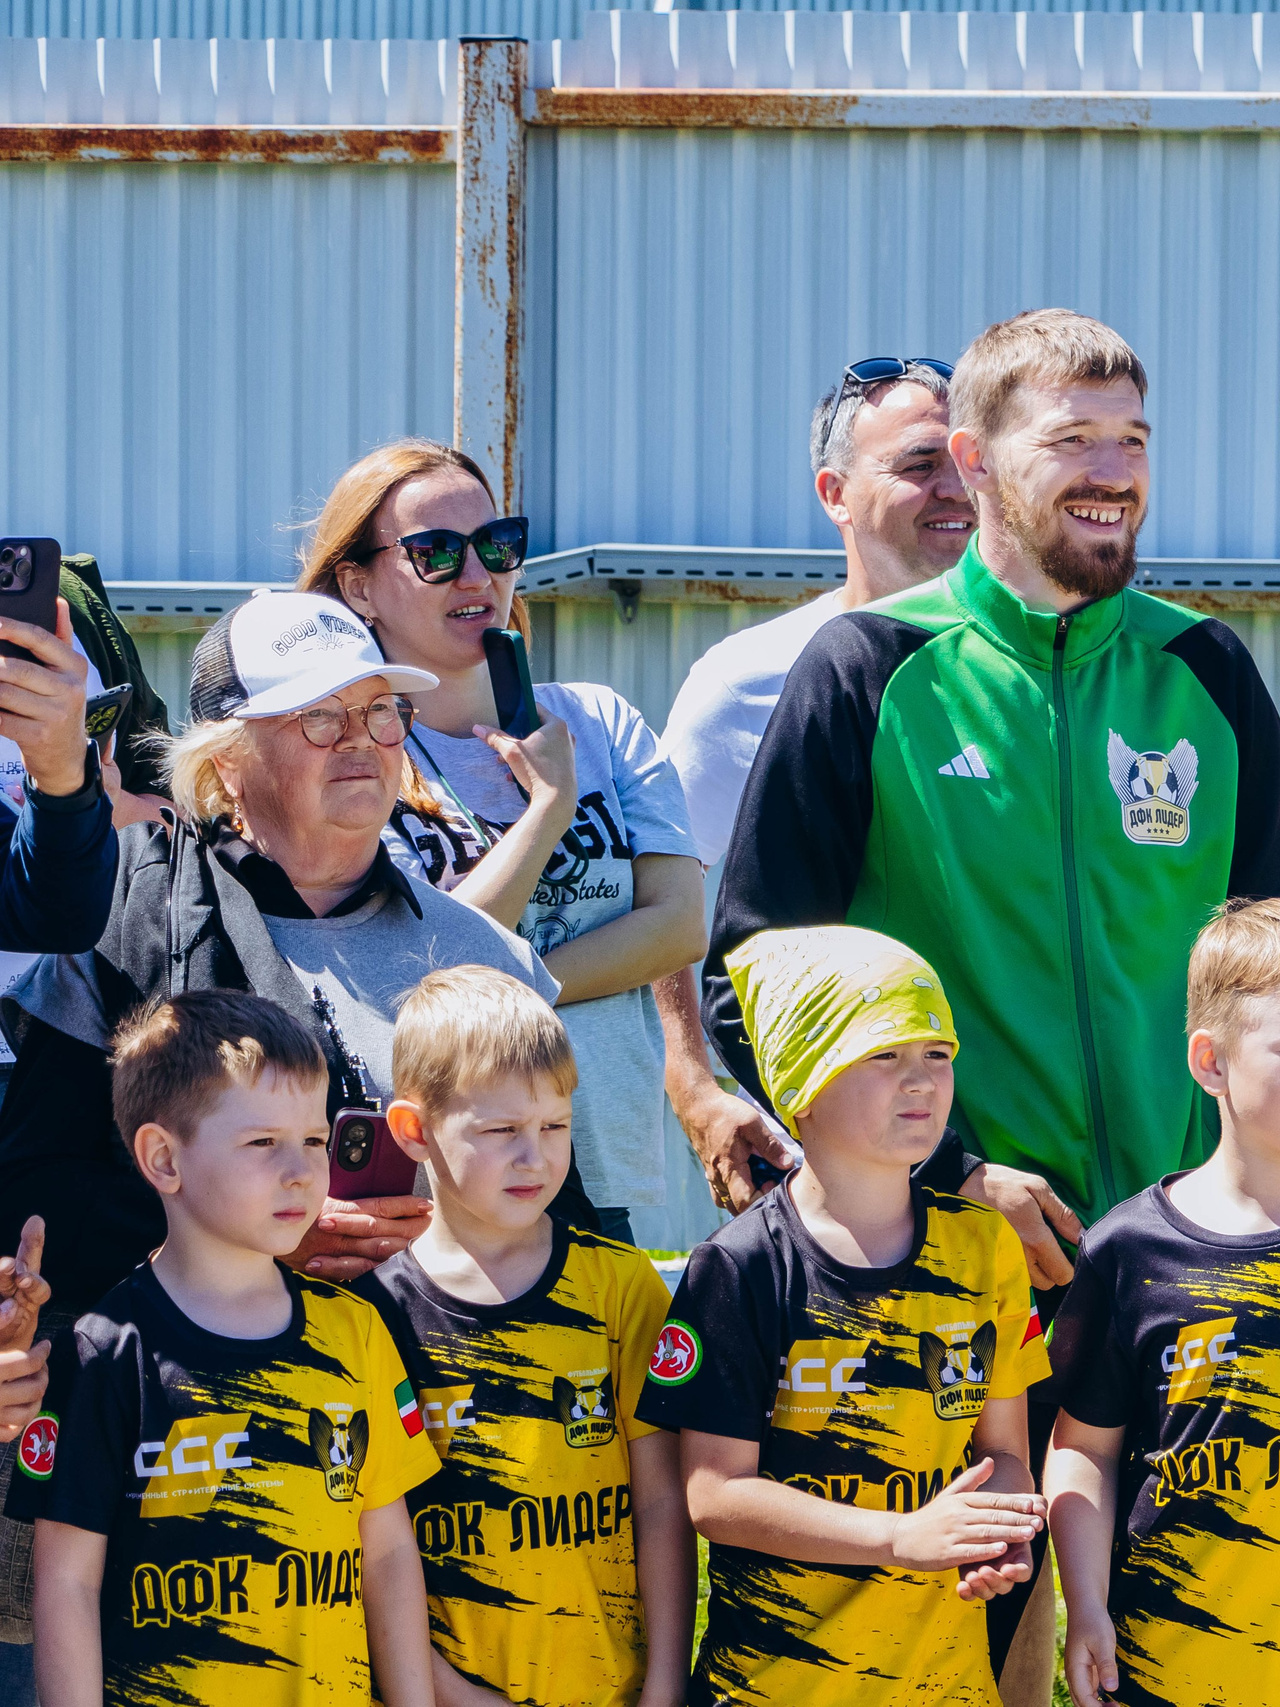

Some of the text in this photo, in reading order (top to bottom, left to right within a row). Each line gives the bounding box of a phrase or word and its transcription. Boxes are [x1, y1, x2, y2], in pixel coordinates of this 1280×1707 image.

[272, 619, 317, 656] GOOD
[1130, 808, 1184, 829] ДФК ЛИДЕР
[561, 877, 620, 905] States
[939, 1387, 989, 1411] ДФК ЛИДЕ
[422, 1399, 477, 1430] СС
[569, 1423, 589, 1441] ДФК
[243, 1480, 284, 1489] СИСТЕМЫ
[412, 1483, 632, 1561] ФК ЛИДЕР
[132, 1547, 363, 1629] ДФК ЛИДЕ
